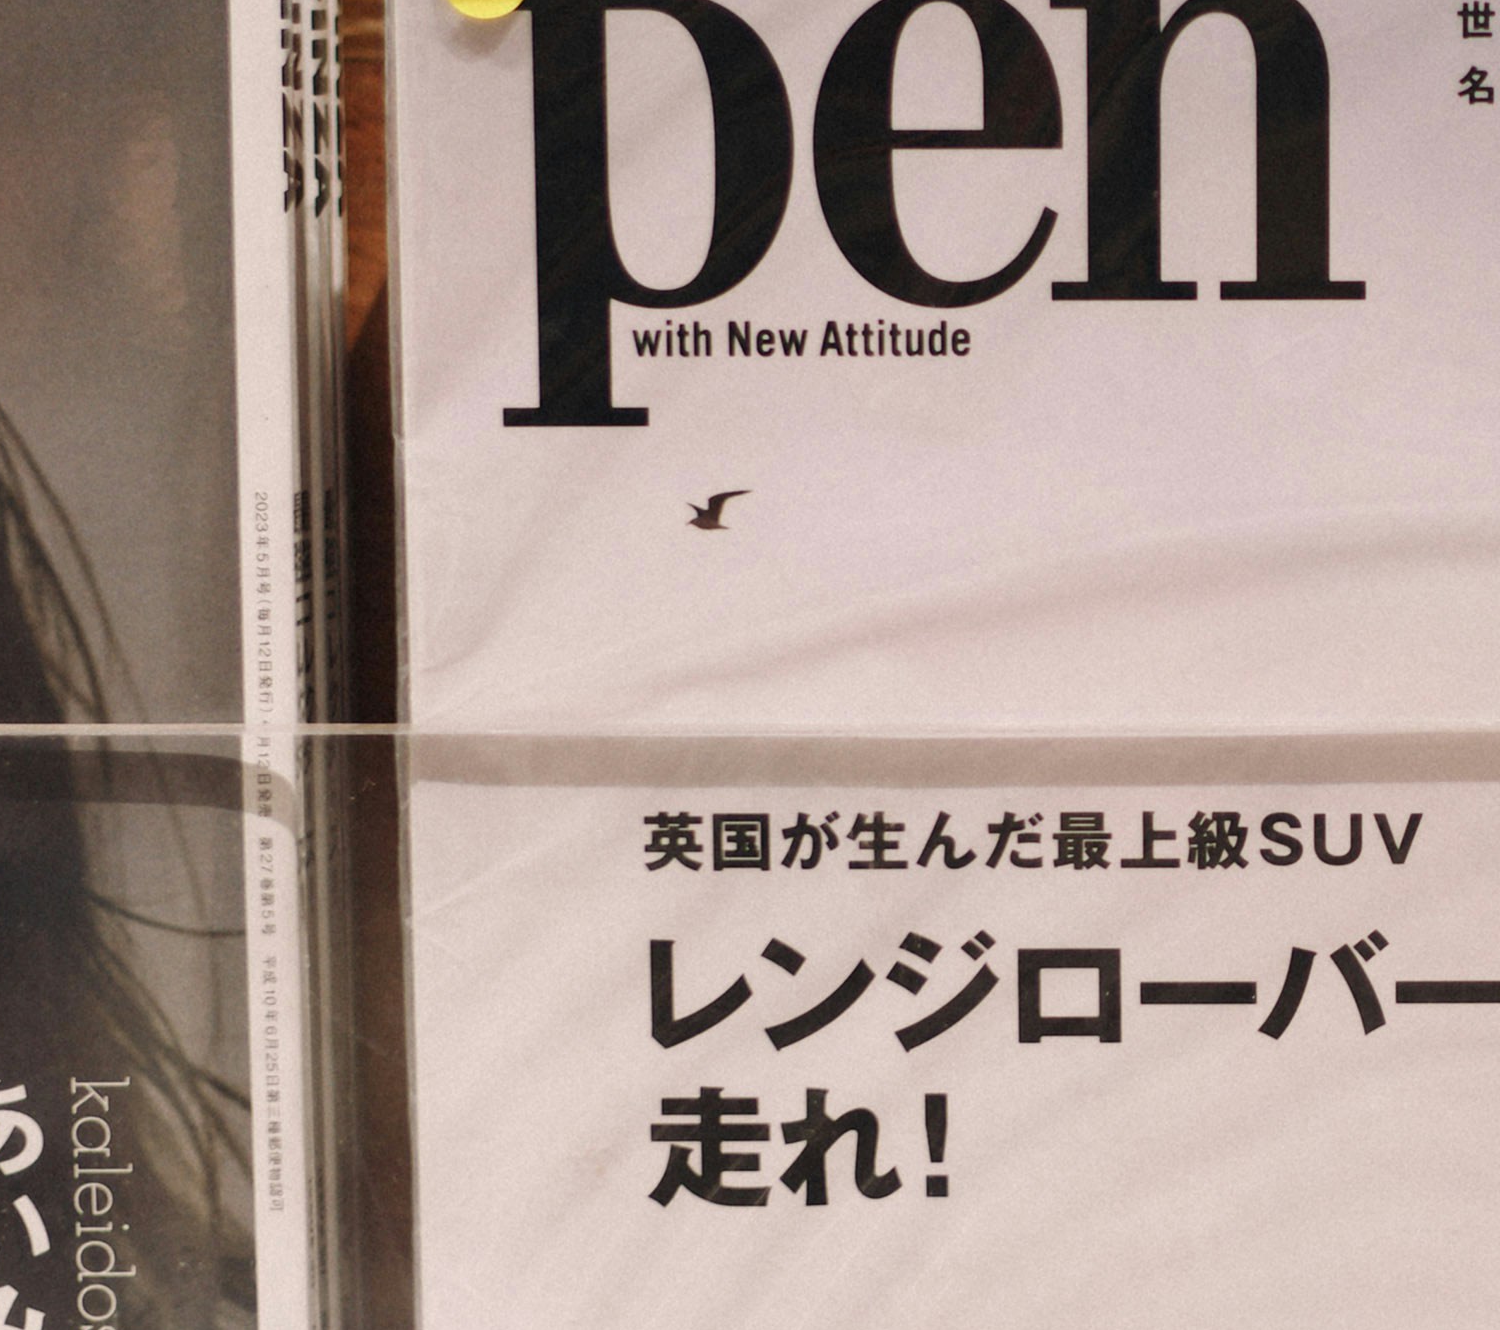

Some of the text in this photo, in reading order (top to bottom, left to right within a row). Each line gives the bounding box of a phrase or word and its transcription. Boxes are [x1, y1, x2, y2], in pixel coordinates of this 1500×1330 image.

[632, 320, 972, 358] with New Attitude
[642, 809, 1425, 871] 英国が生んだ最上級SUV
